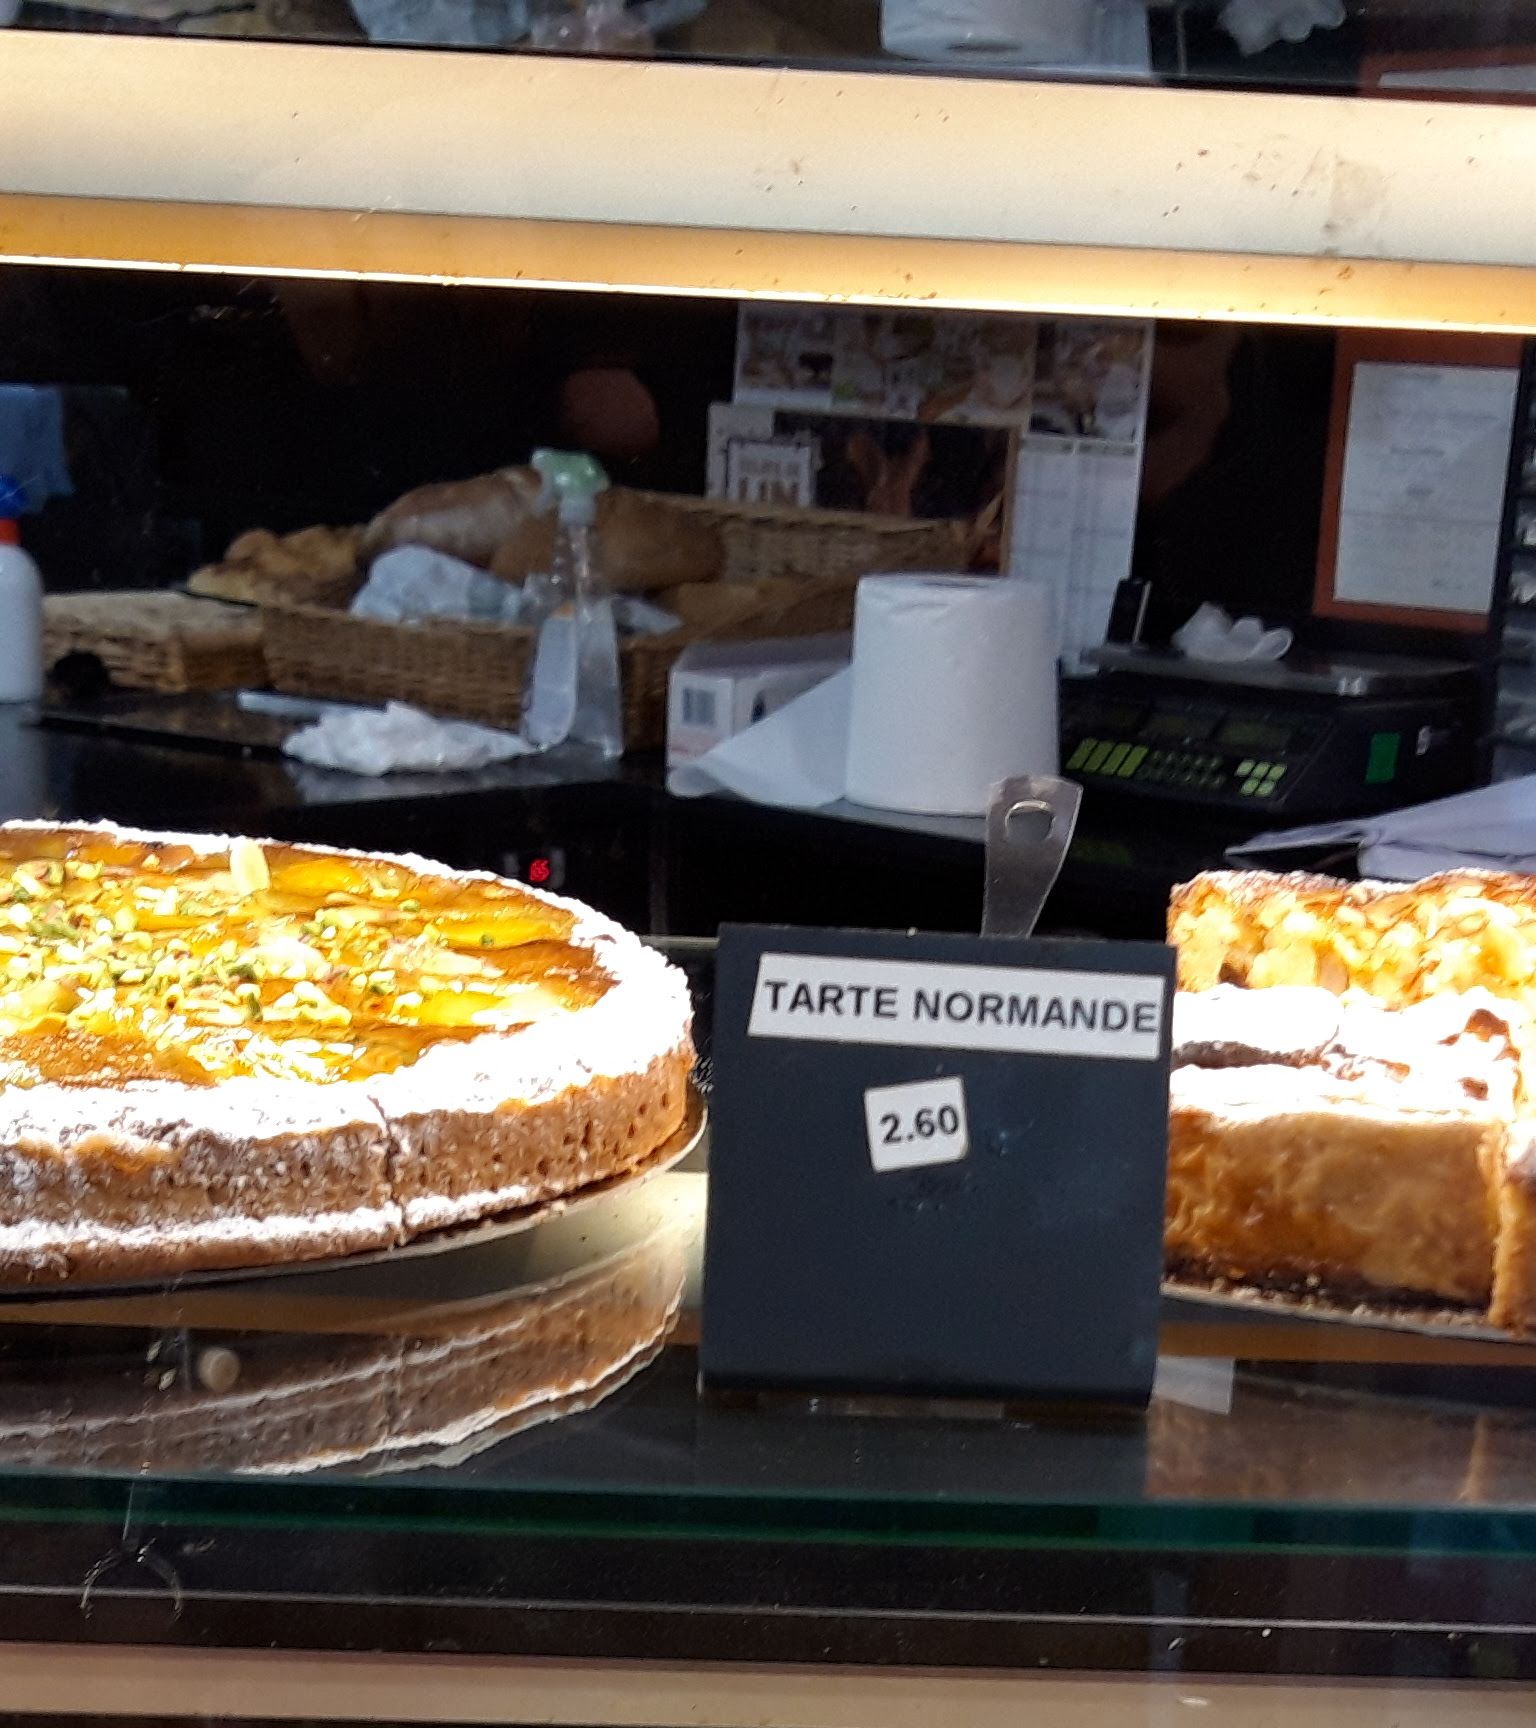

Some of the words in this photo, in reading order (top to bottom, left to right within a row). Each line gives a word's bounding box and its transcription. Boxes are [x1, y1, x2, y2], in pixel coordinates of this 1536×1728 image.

[764, 980, 899, 1019] TARTE
[913, 988, 1159, 1034] NORMANDE
[879, 1104, 960, 1146] 2.60
